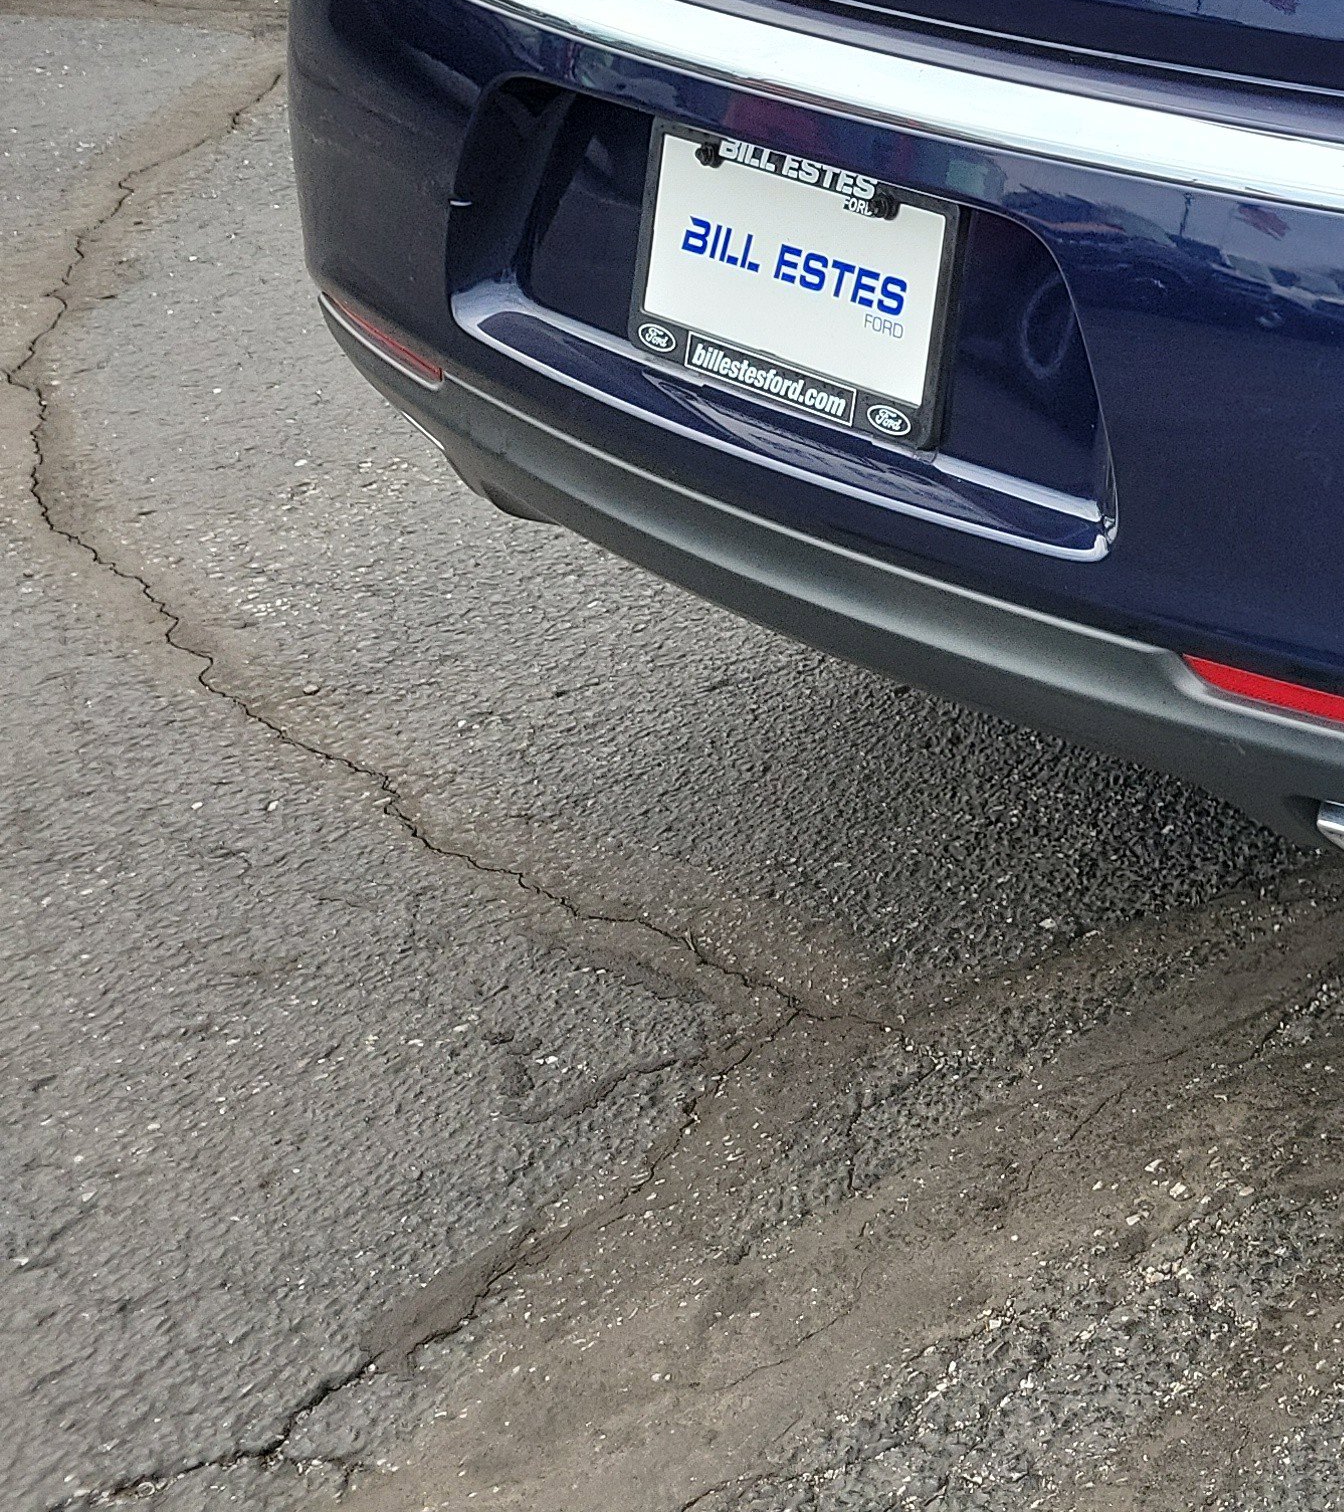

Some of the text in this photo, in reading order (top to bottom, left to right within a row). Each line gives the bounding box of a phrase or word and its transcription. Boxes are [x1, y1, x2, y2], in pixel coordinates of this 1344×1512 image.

[718, 138, 878, 201] BILL ESTES
[681, 215, 907, 316] BILL ESTES
[643, 326, 670, 349] Ford
[864, 314, 904, 339] FORD
[691, 343, 847, 416] billestesford.com
[873, 406, 903, 432] Ford
